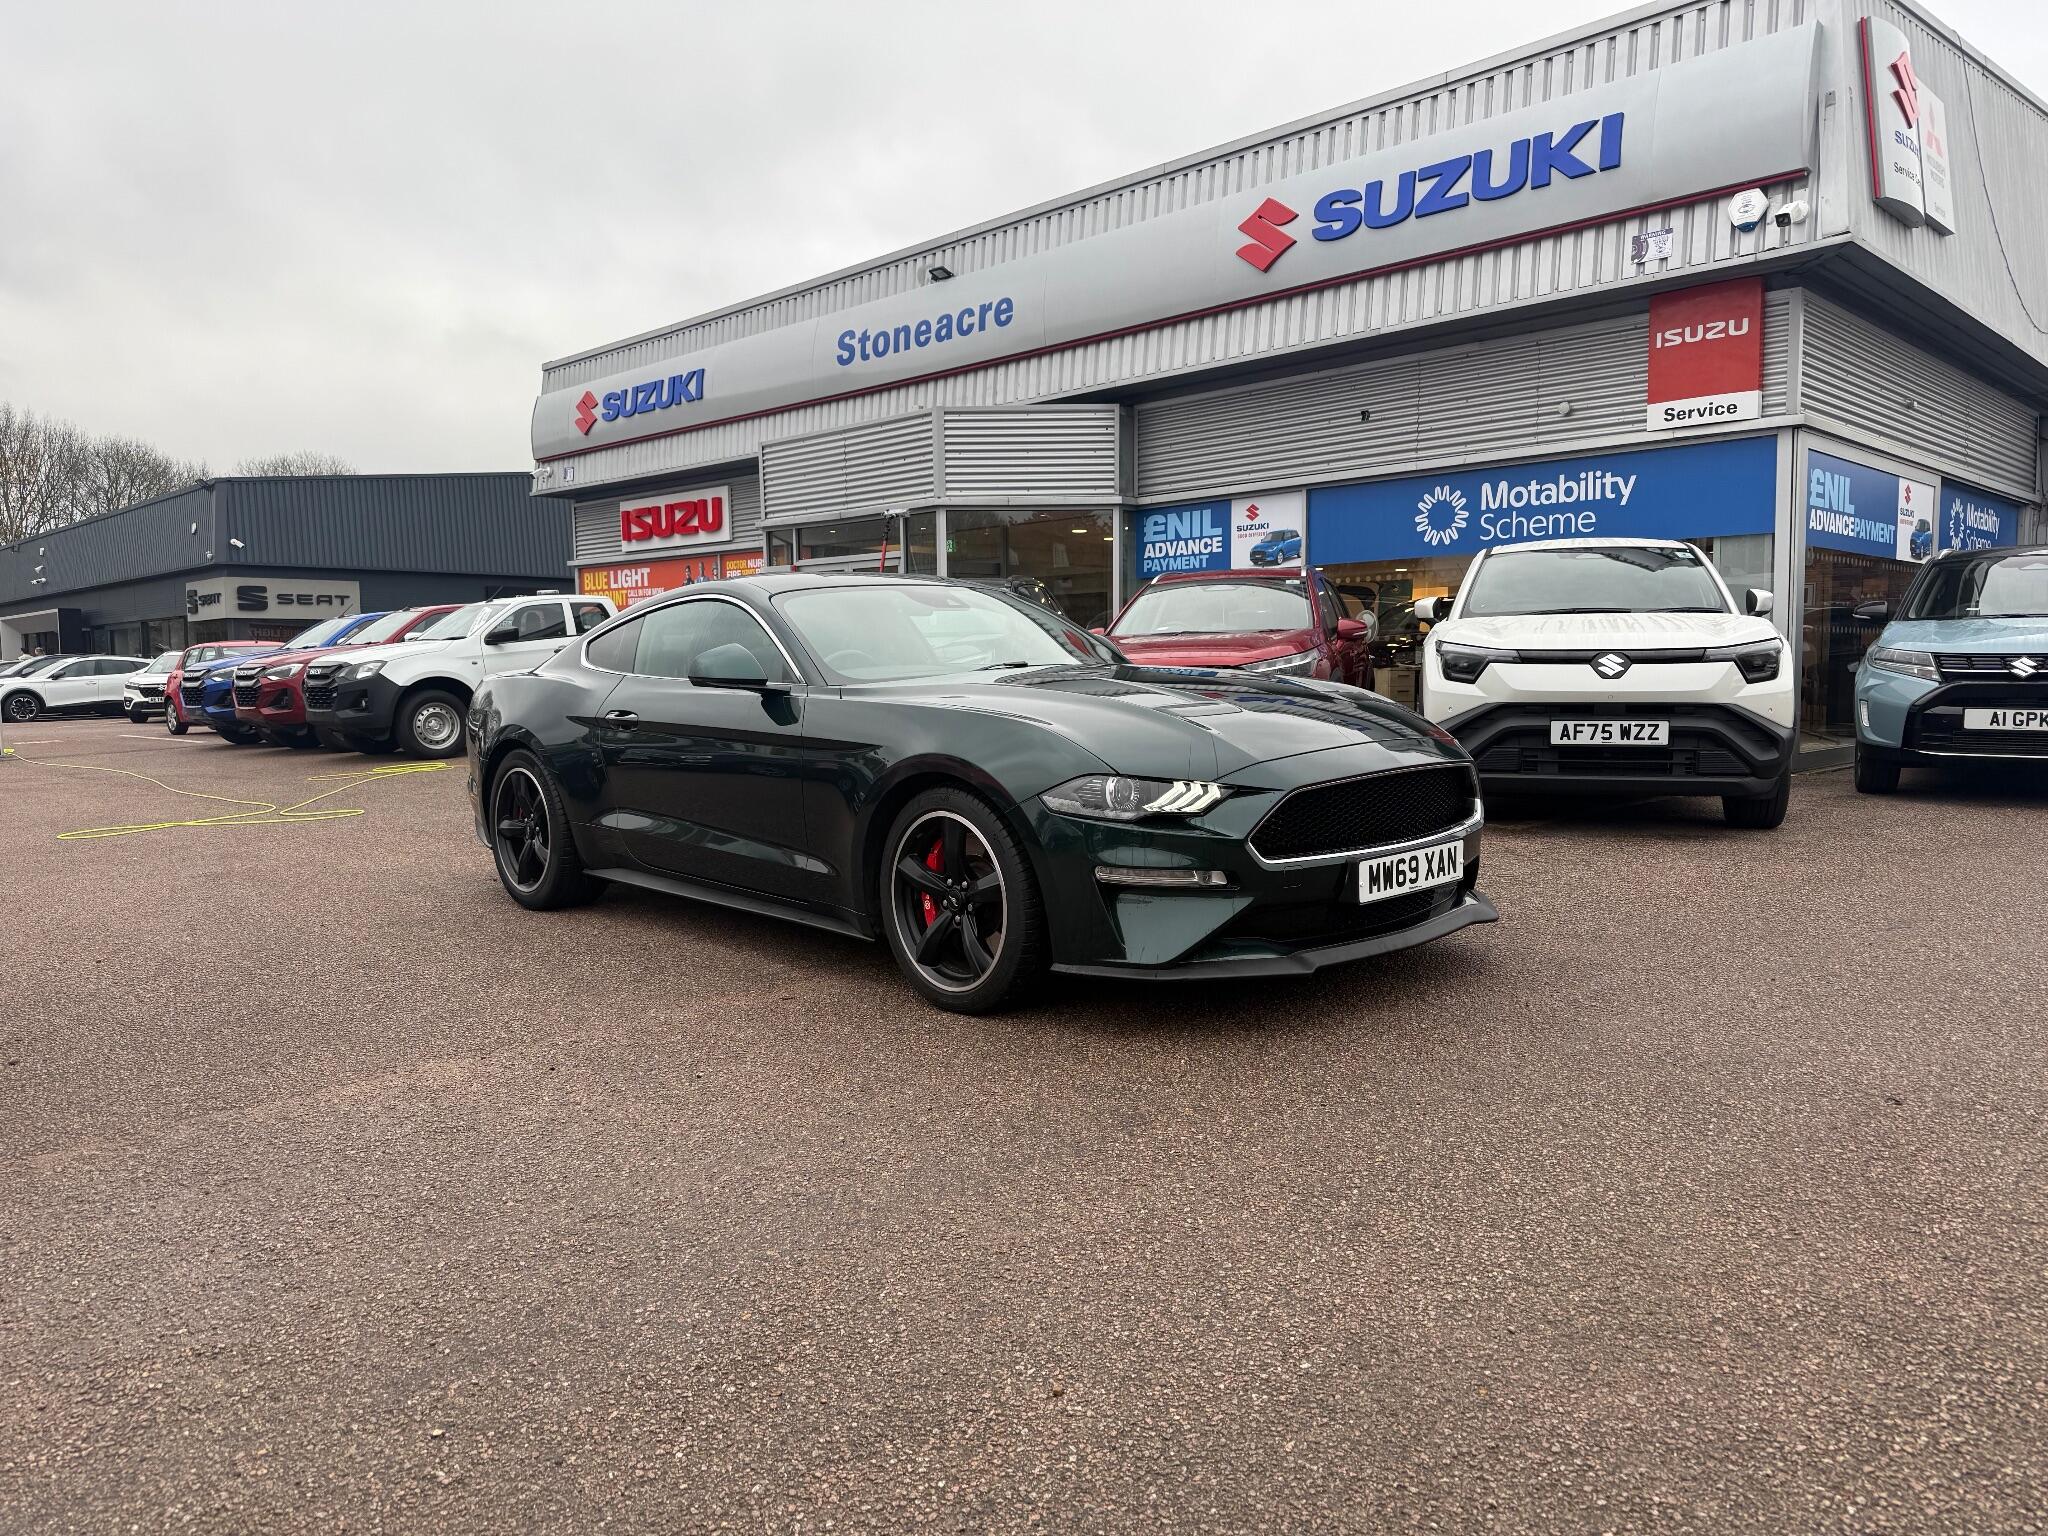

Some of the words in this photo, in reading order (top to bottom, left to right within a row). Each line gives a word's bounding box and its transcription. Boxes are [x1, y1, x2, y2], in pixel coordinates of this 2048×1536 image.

[1311, 111, 1624, 242] SUZUKI
[836, 296, 1015, 367] Stoneacre
[1656, 317, 1749, 349] ISUZU
[601, 368, 704, 422] SUZUKI
[1663, 402, 1738, 422] Service
[1480, 471, 1637, 529] Motability
[1809, 468, 1855, 514] £NIL
[621, 496, 723, 543] ISUZU
[1143, 508, 1223, 543] £NIL
[1236, 522, 1270, 532] SUZUKI
[1479, 511, 1596, 541] Scheme
[1809, 508, 1855, 536] ADVANCE
[1855, 522, 1896, 545] PAYMENT
[1966, 502, 2001, 540] Motability
[1143, 536, 1223, 559] ADVANCE
[1143, 554, 1210, 573] PAYMENT
[584, 571, 609, 591] BLUE
[609, 567, 651, 589] LIGHT
[276, 593, 351, 606] SEAT
[1560, 723, 1613, 741] AF75
[1620, 723, 1660, 741] WZZ
[1368, 855, 1419, 894] MW69
[1424, 846, 1457, 882] XAN
